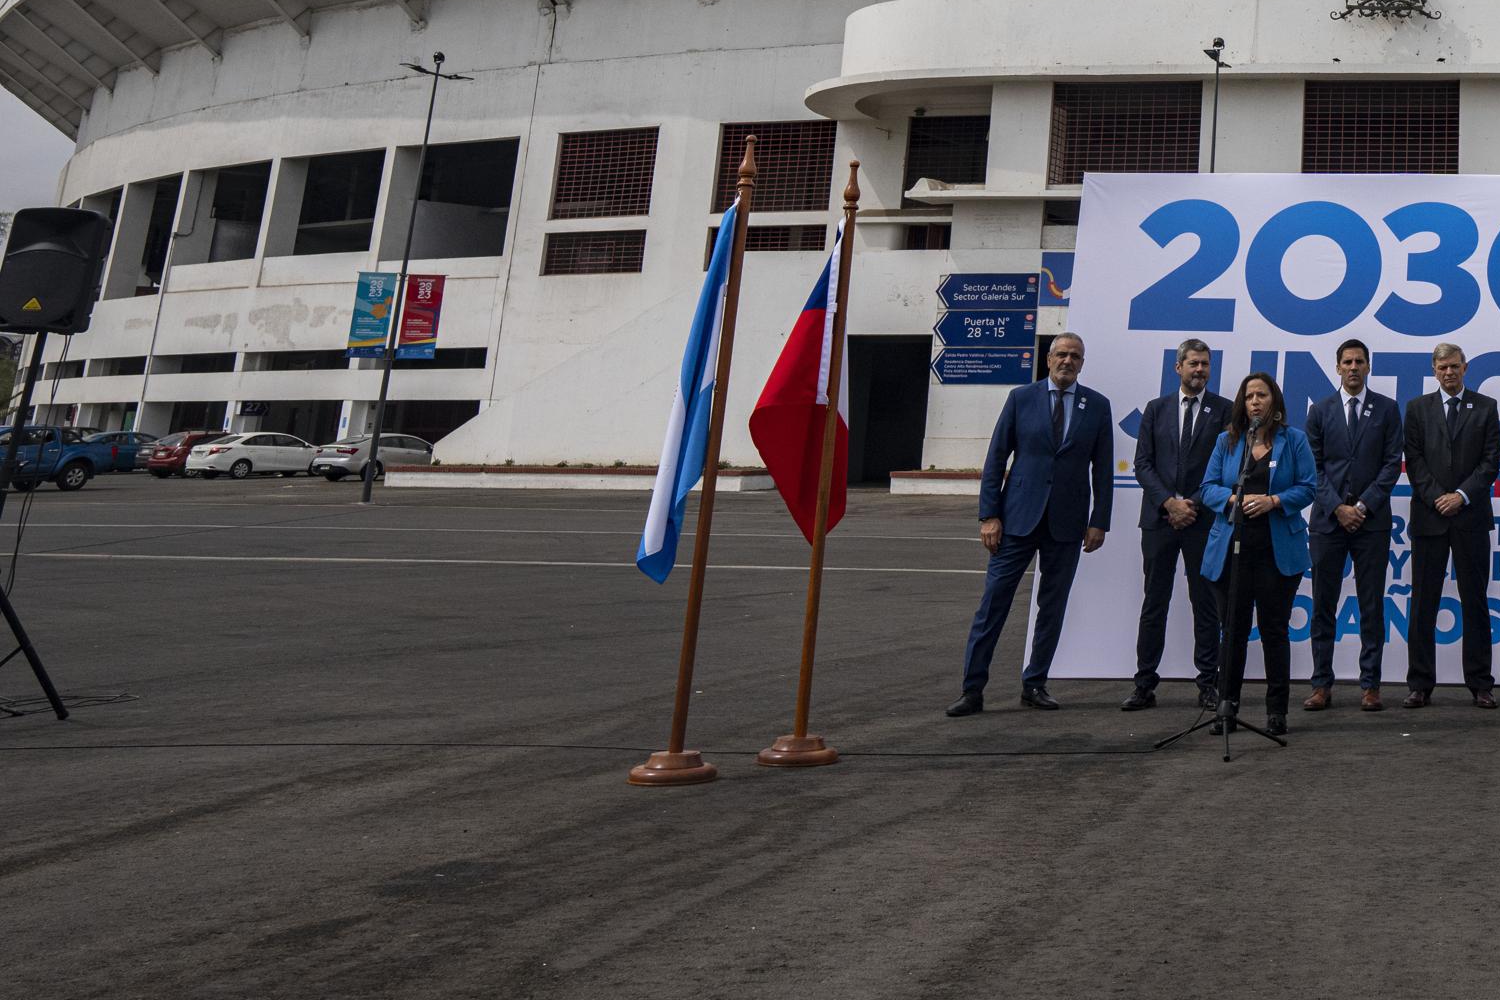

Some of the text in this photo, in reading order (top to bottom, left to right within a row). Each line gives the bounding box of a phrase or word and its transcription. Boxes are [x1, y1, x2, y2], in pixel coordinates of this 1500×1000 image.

[963, 283, 989, 292] Sector
[991, 283, 1017, 292] Andes
[953, 292, 1026, 301] Sector Galería Sur
[964, 317, 995, 326] Puerta
[967, 327, 982, 338] 28
[993, 327, 1005, 338] 15
